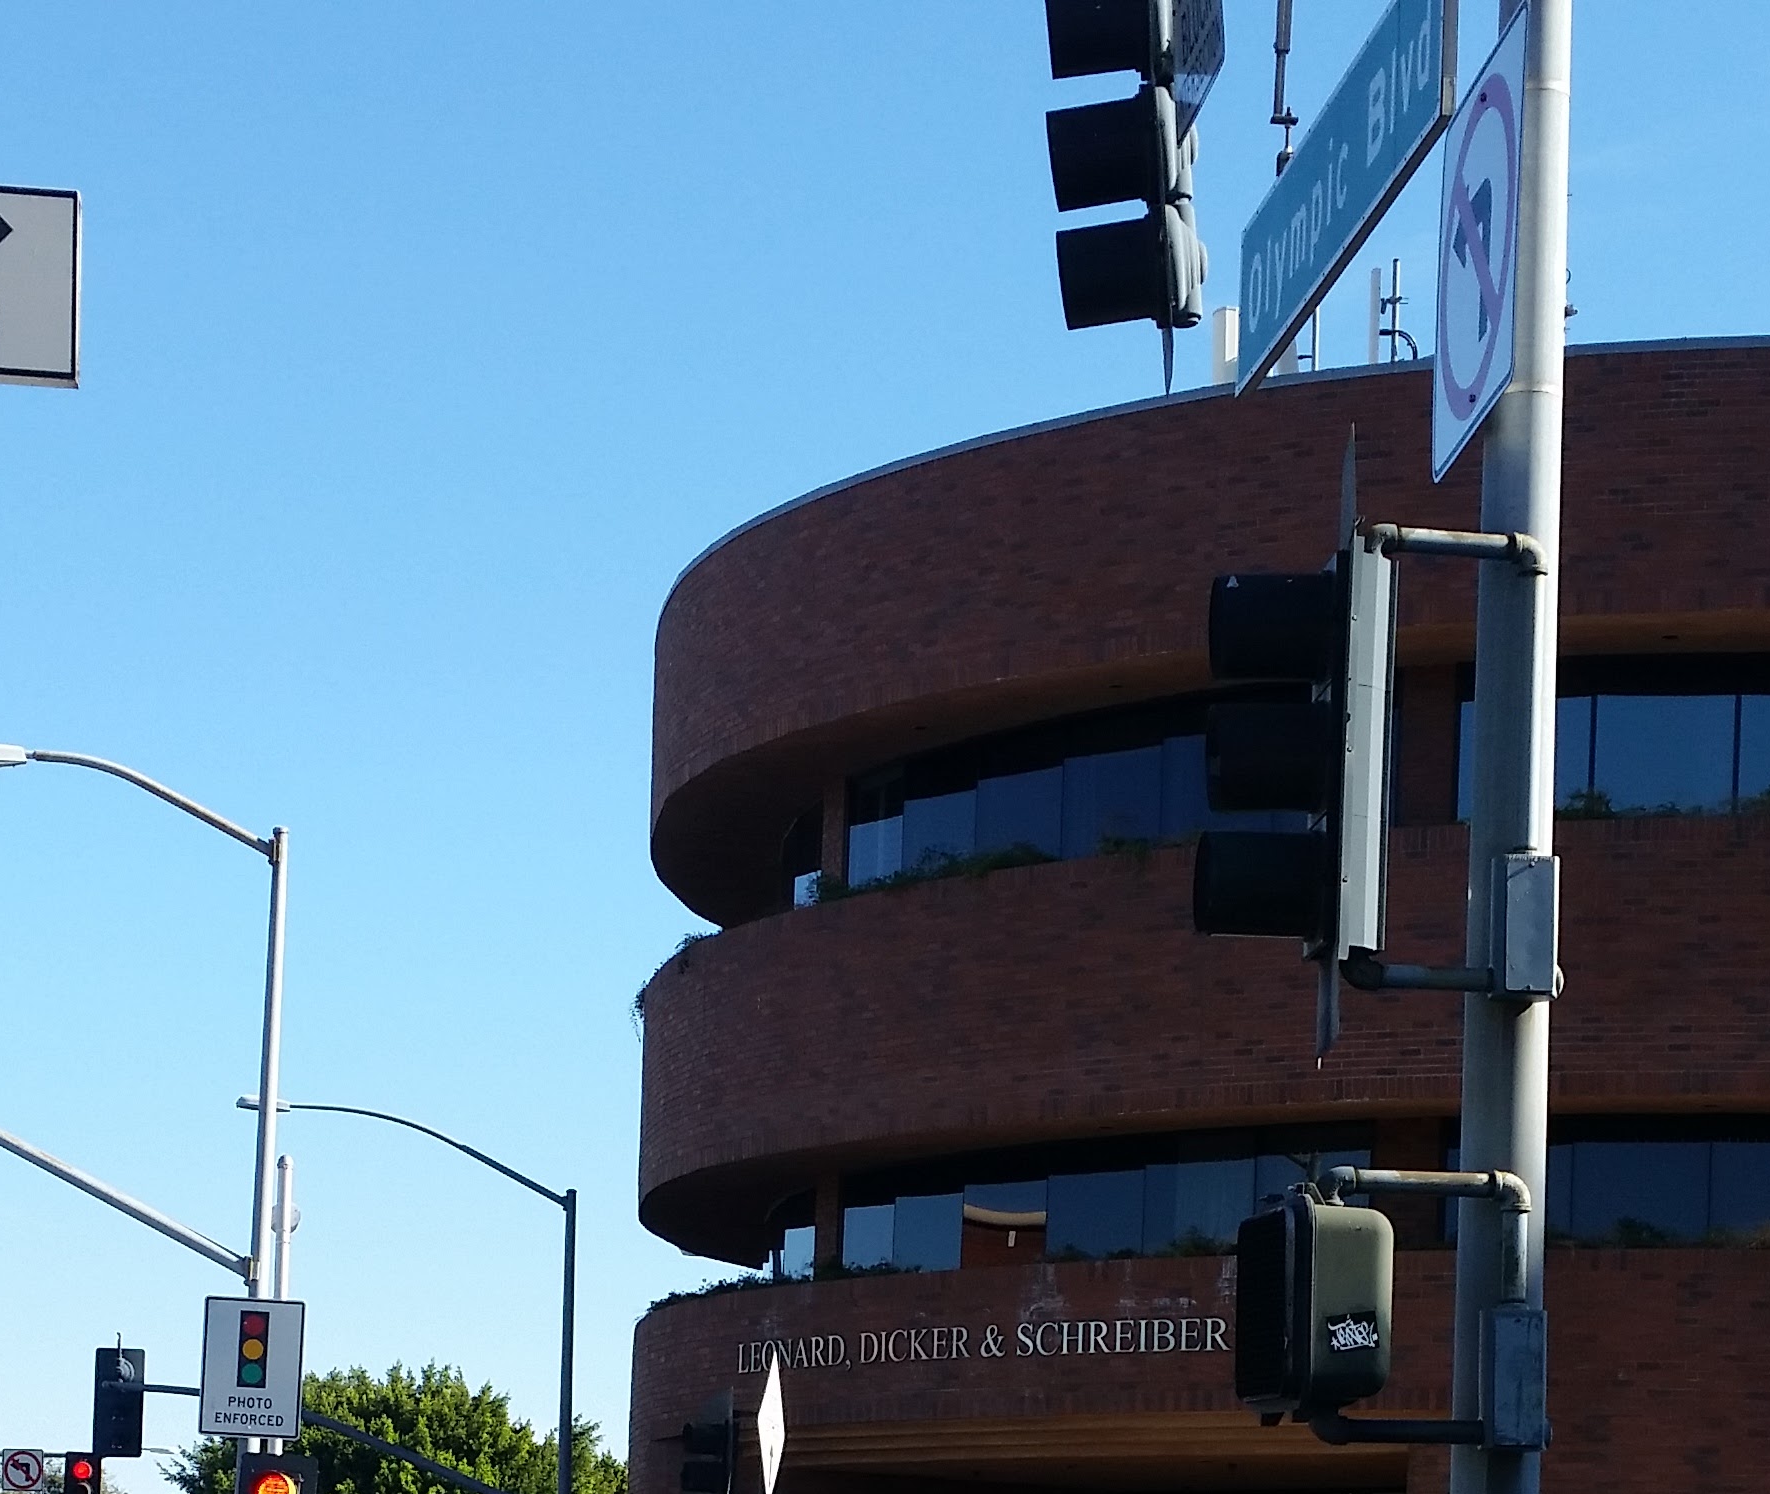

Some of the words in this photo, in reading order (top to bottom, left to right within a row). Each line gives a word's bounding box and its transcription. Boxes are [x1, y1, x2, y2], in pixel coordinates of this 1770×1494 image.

[1248, 137, 1349, 333] Olympic
[1366, 0, 1433, 168] Blvd
[737, 1334, 852, 1374] LEONARD,
[858, 1326, 971, 1364] DICKER
[980, 1324, 1006, 1358] &
[1015, 1317, 1231, 1357] SCHREIBER
[214, 1412, 285, 1427] ENFORCED
[228, 1396, 273, 1410] PHOTO
